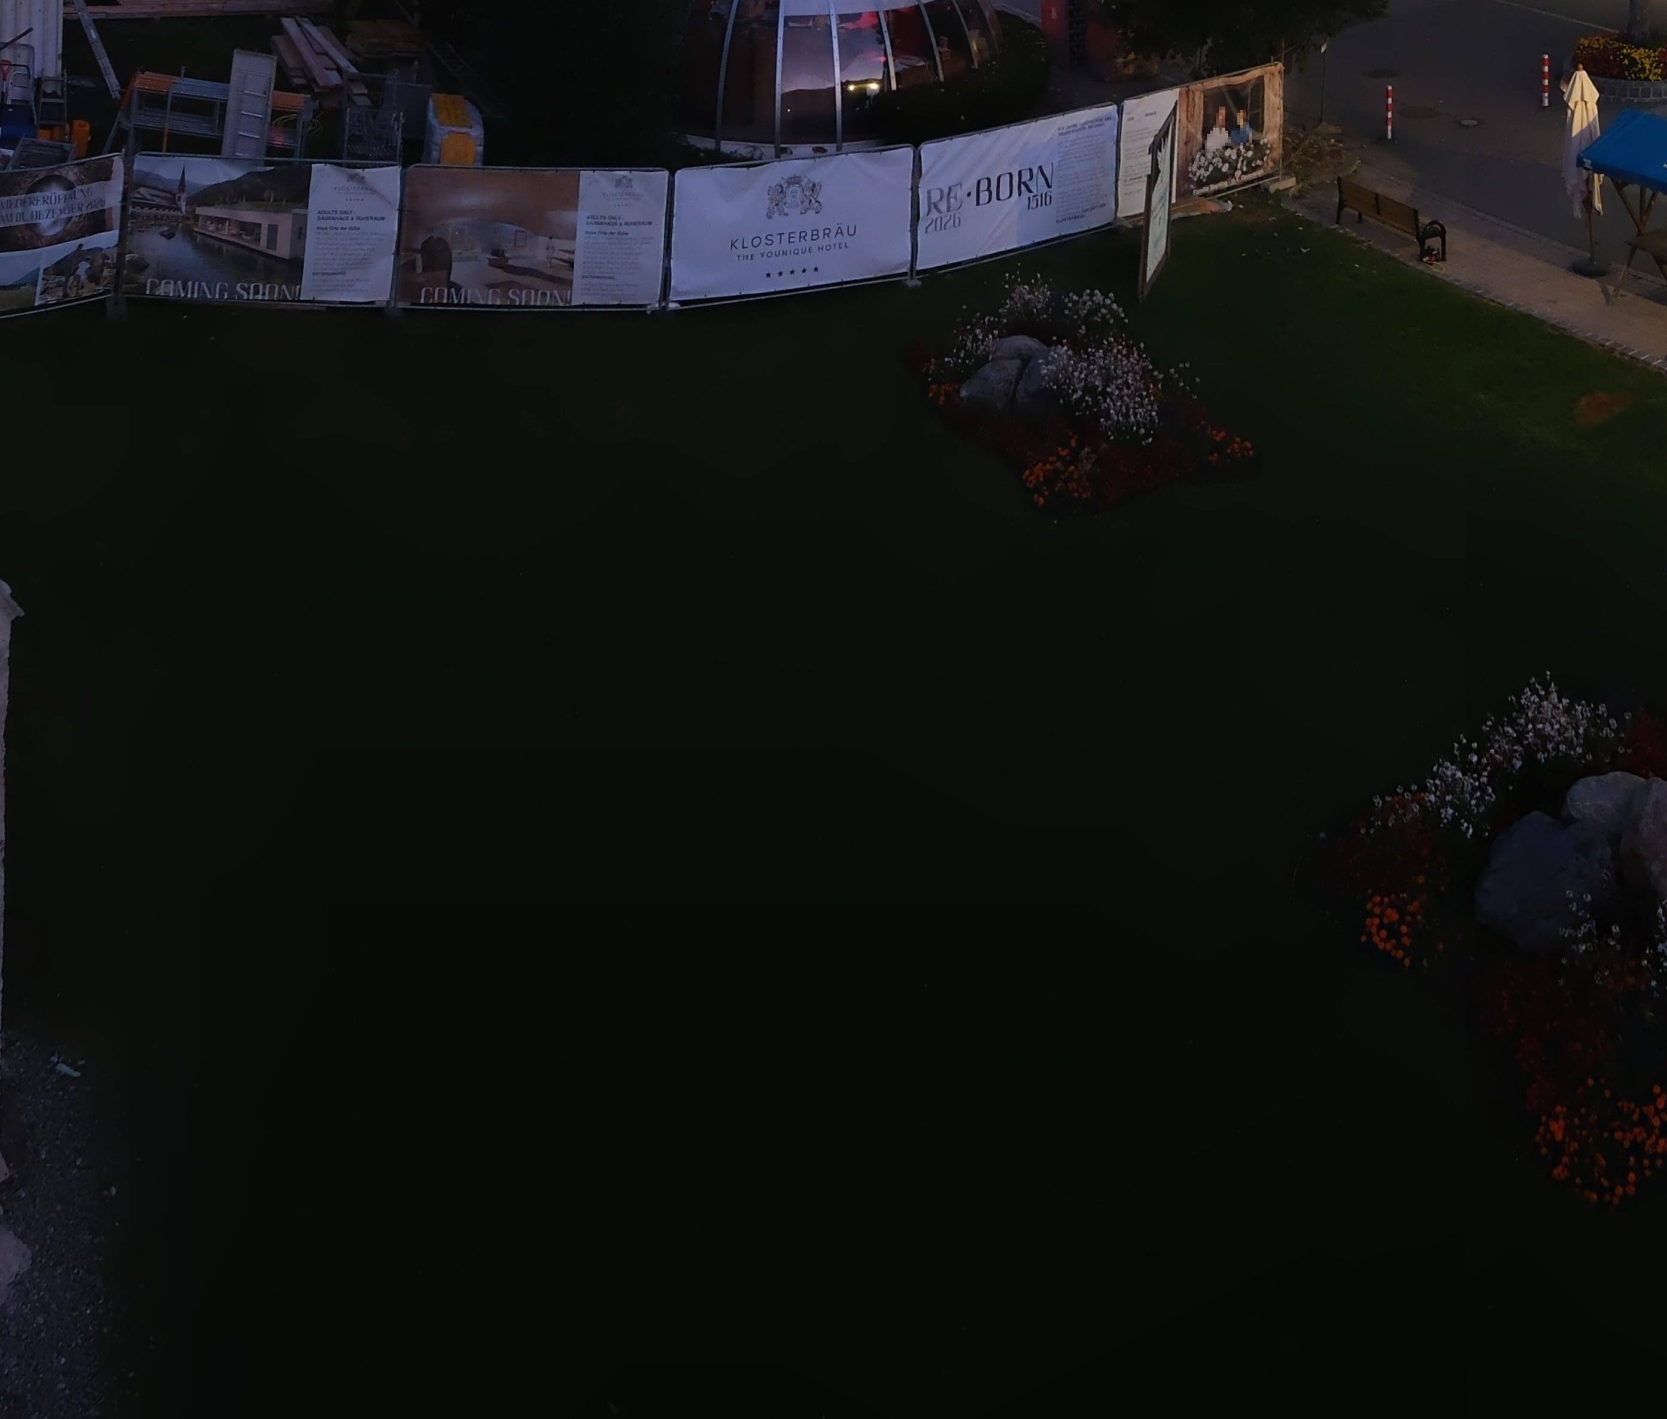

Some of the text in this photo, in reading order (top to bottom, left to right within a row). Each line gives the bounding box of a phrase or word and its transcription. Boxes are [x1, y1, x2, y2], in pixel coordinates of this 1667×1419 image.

[1027, 191, 1053, 211] 1516
[925, 212, 961, 233] 2026
[730, 222, 857, 251] KLOSTERBRÄU
[737, 242, 849, 261] THE YOUNIQUE HOTEL
[146, 278, 301, 302] COMING SOON!
[420, 286, 572, 305] COMING SOON!
